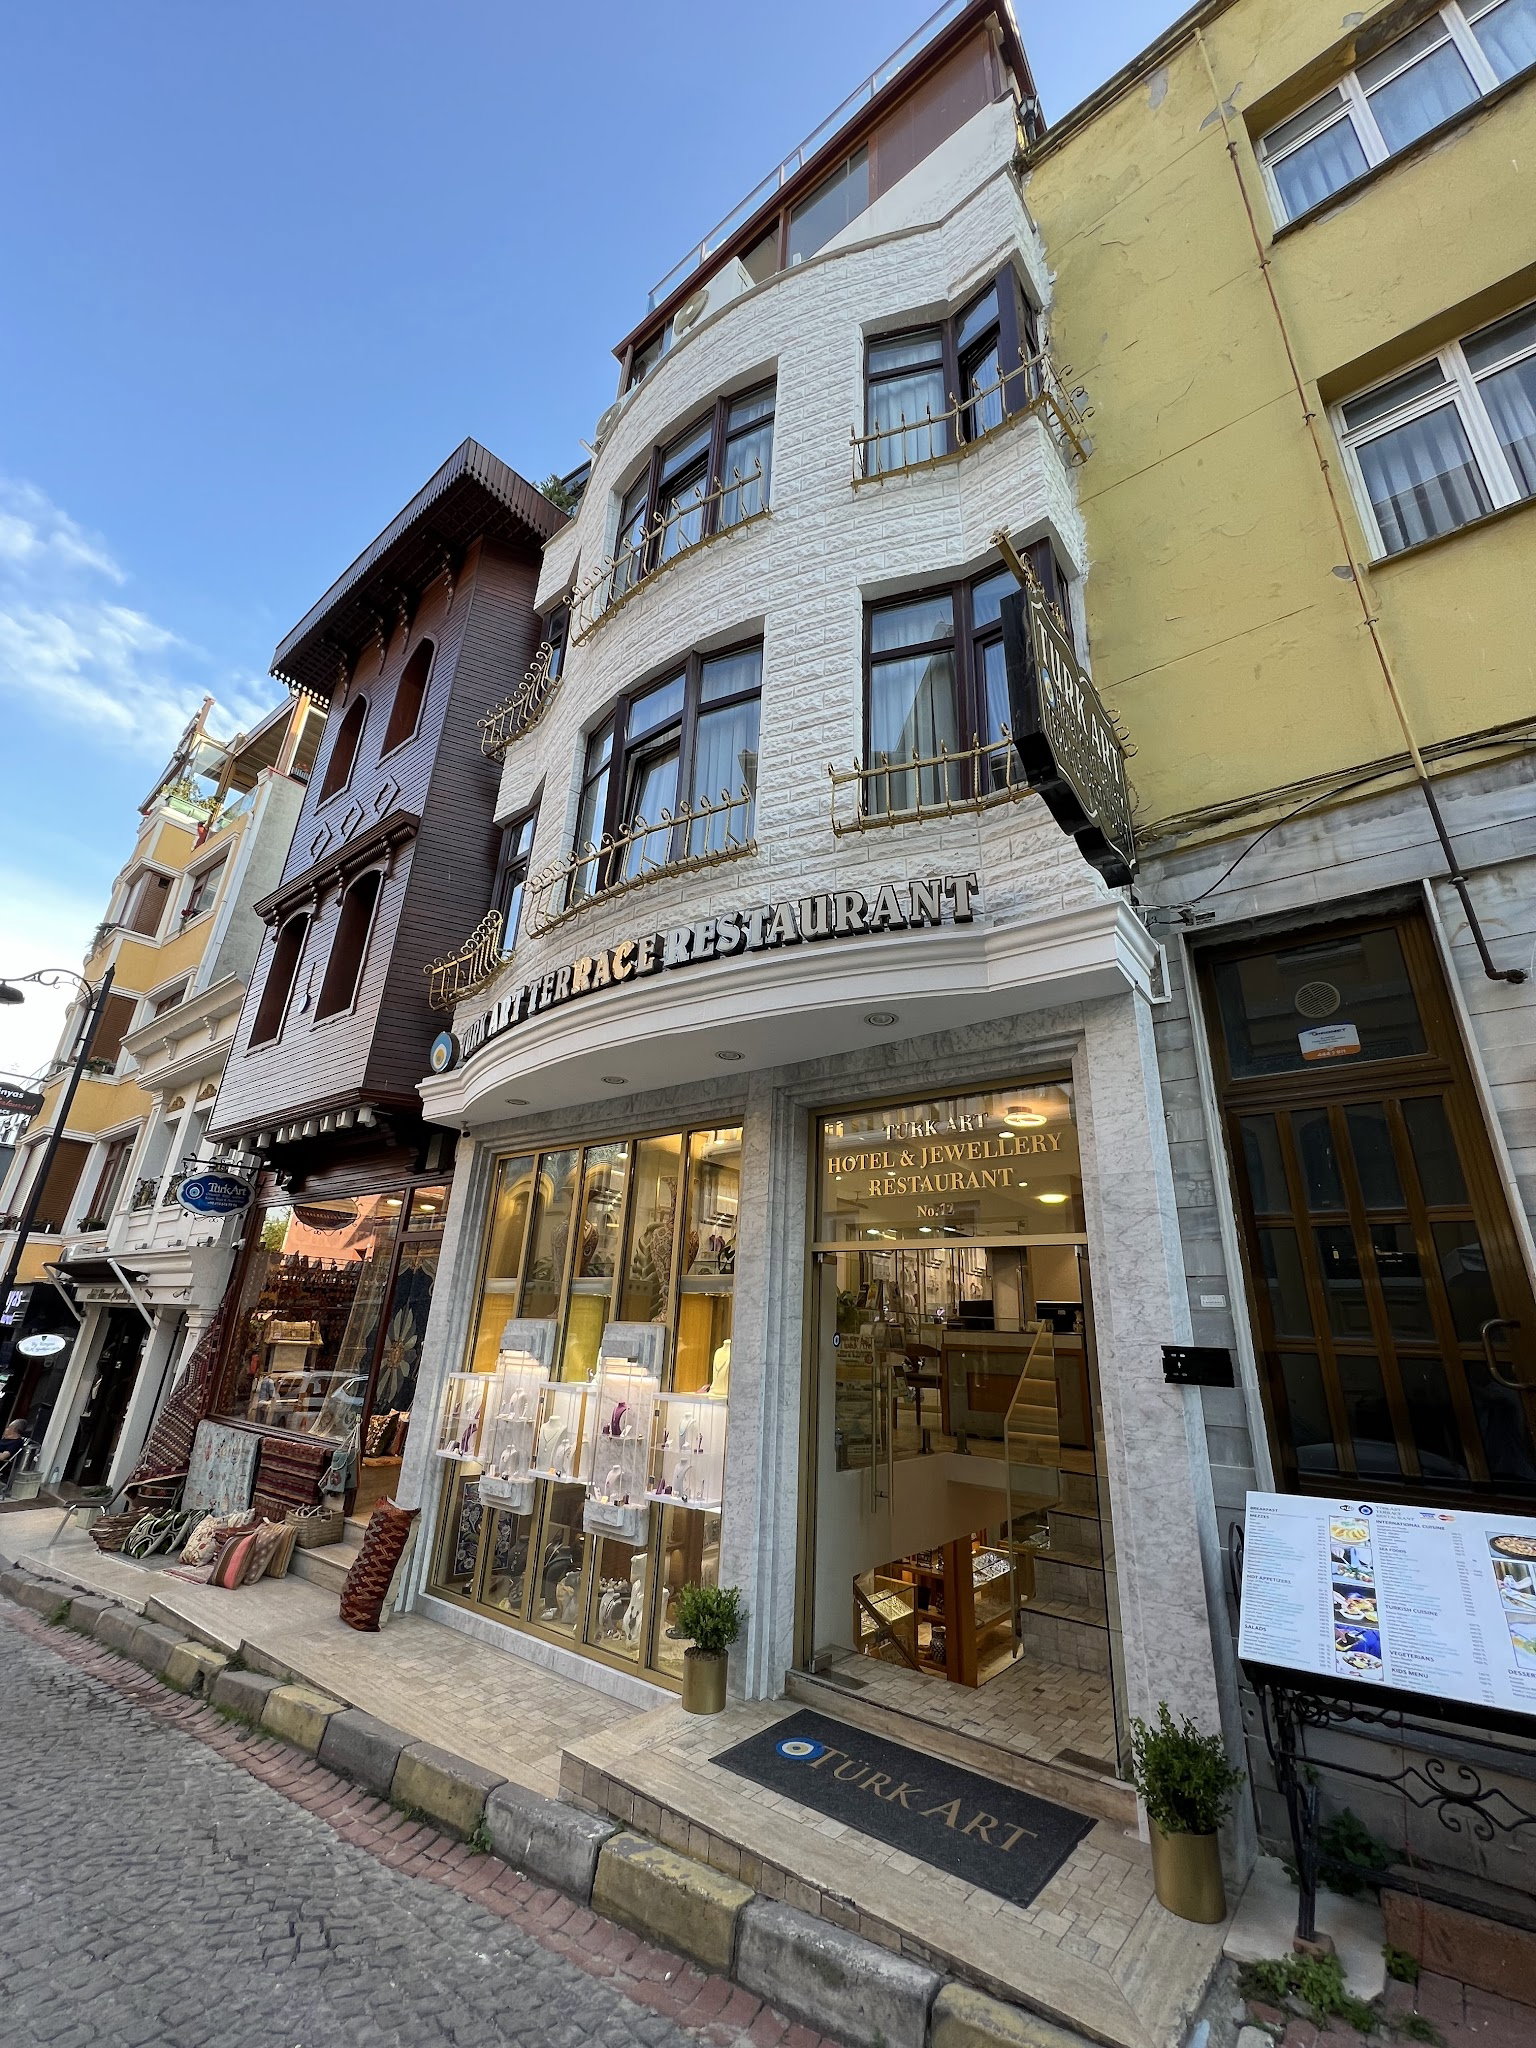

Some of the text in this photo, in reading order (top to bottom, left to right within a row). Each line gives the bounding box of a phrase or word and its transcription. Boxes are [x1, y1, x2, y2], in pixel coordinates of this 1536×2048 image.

[1091, 712, 1121, 785] ART
[528, 934, 661, 1015] TERRACE
[664, 872, 979, 967] RESTAURANT
[946, 1112, 988, 1133] ART
[827, 1132, 1062, 1174] HOTEL & JEWELLERY
[869, 1168, 1014, 1197] RESTAURANT
[1244, 1623, 1267, 1632] SALADS
[1391, 1667, 1429, 1679] KIDS MENU
[809, 1744, 1038, 1853] TÜRK ART
